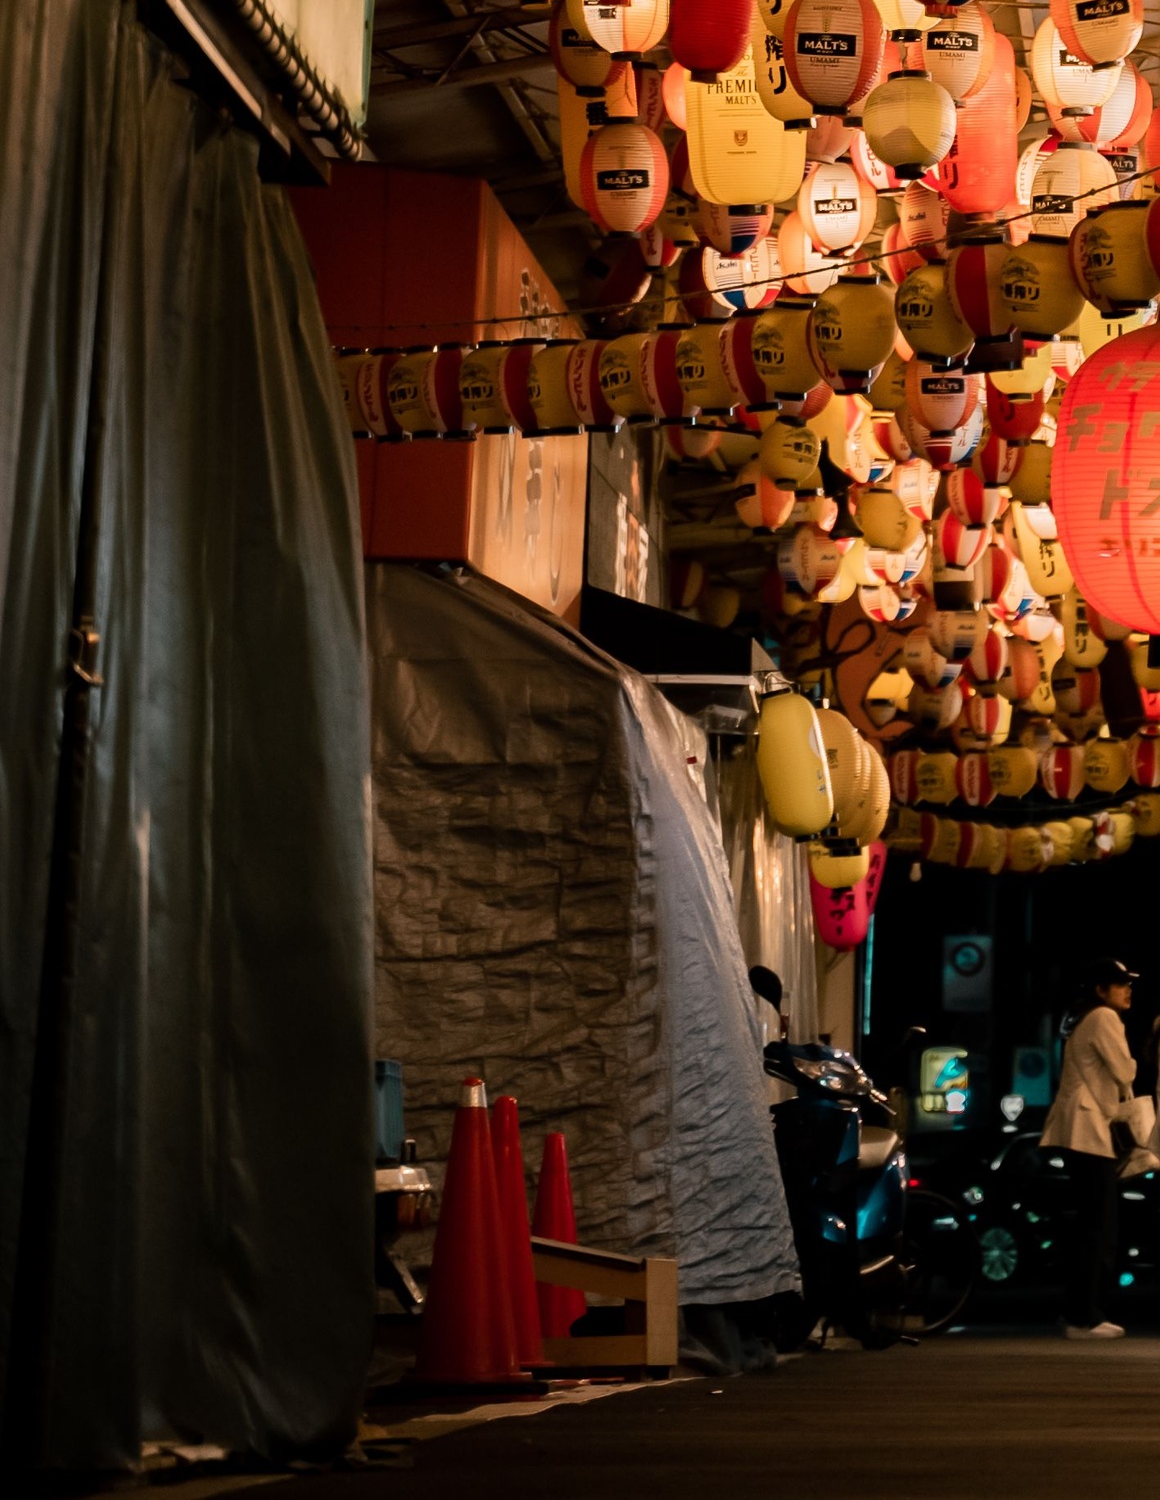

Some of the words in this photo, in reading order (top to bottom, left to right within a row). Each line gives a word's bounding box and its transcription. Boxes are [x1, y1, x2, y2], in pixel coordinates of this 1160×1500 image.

[804, 39, 849, 52] MALT'S
[934, 36, 973, 47] MALT'S
[809, 56, 840, 66] UMAMI
[725, 95, 757, 106] MALT'S
[604, 173, 645, 186] MALT'S
